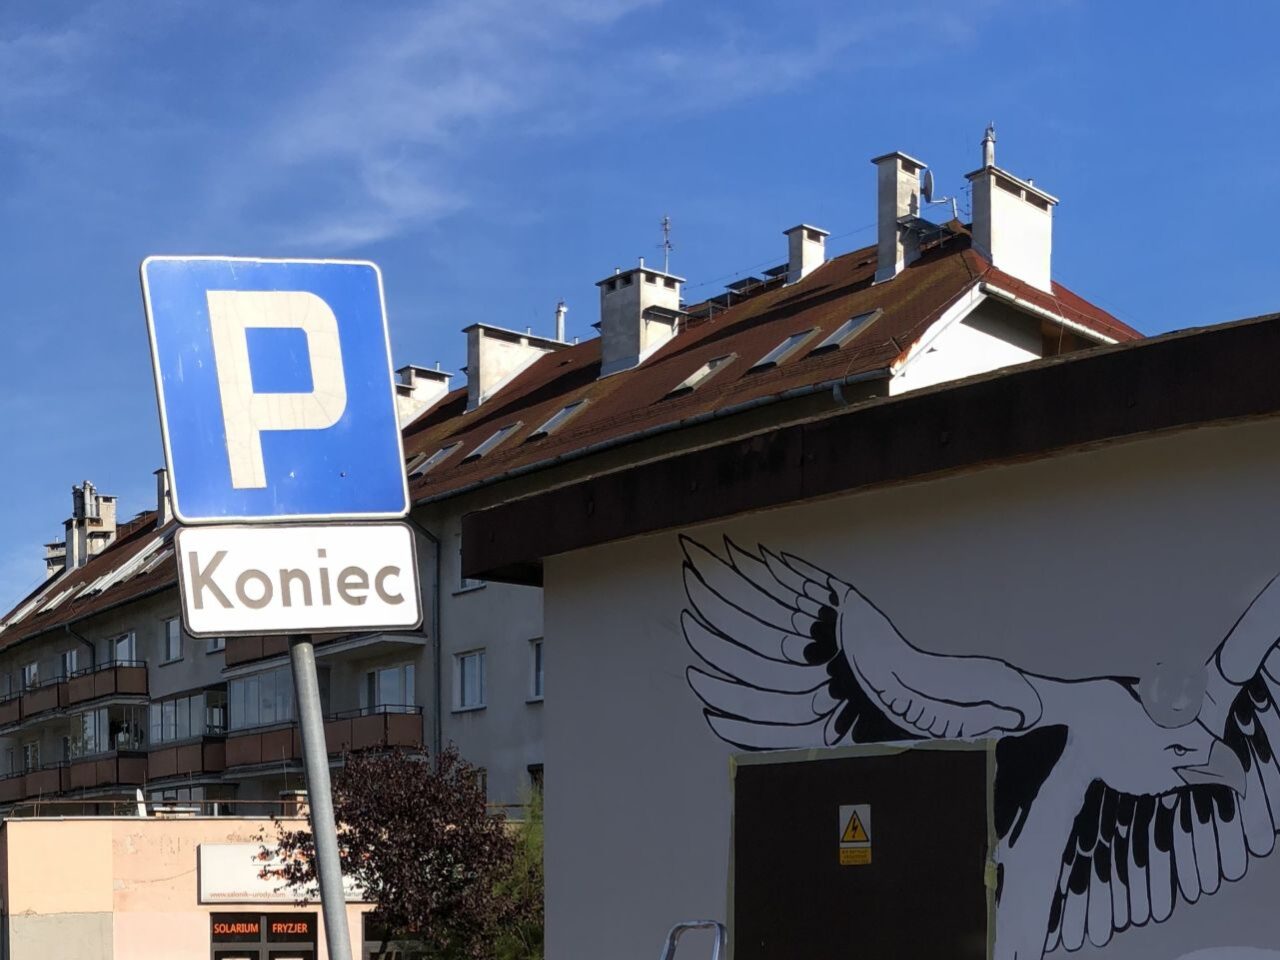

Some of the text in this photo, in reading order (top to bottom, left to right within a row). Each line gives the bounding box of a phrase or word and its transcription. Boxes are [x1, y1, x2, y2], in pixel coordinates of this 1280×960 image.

[206, 290, 347, 489] P
[188, 548, 405, 609] Koniec
[214, 923, 259, 934] SOLARIUM
[272, 923, 308, 933] FRYZJER
